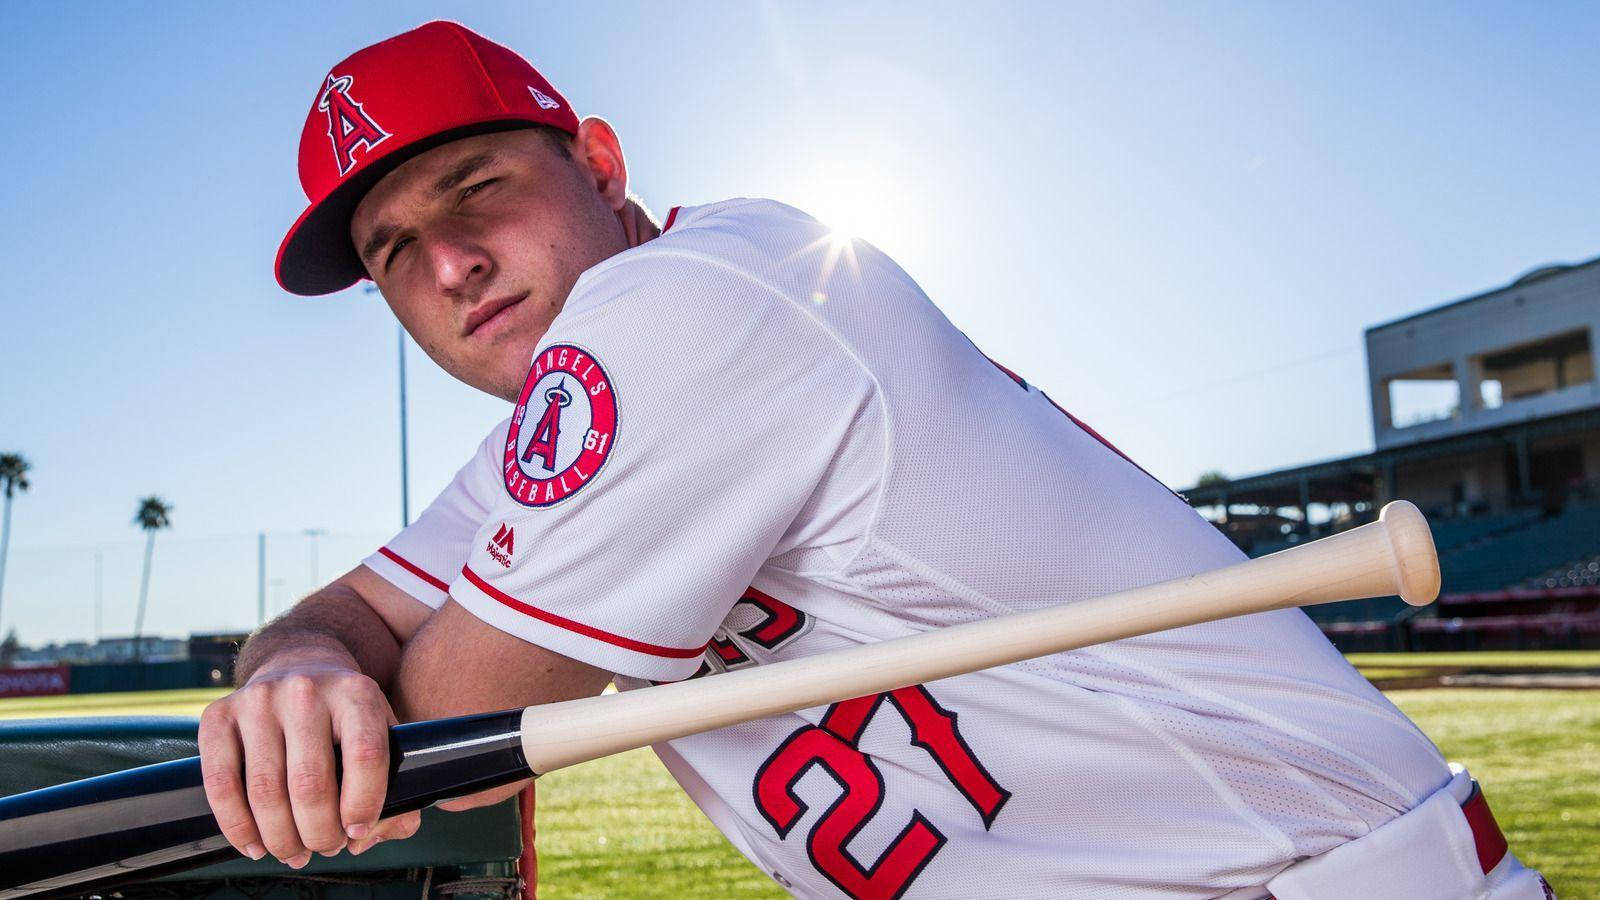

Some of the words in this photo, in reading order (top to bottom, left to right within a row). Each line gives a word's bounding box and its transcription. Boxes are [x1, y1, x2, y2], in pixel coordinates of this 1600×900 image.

[318, 74, 393, 177] A
[535, 349, 606, 396] ANGELS
[522, 376, 573, 472] A
[584, 429, 610, 455] 61
[505, 439, 588, 501] BASEBALL
[485, 541, 511, 568] Majestic
[752, 683, 1013, 900] 27
